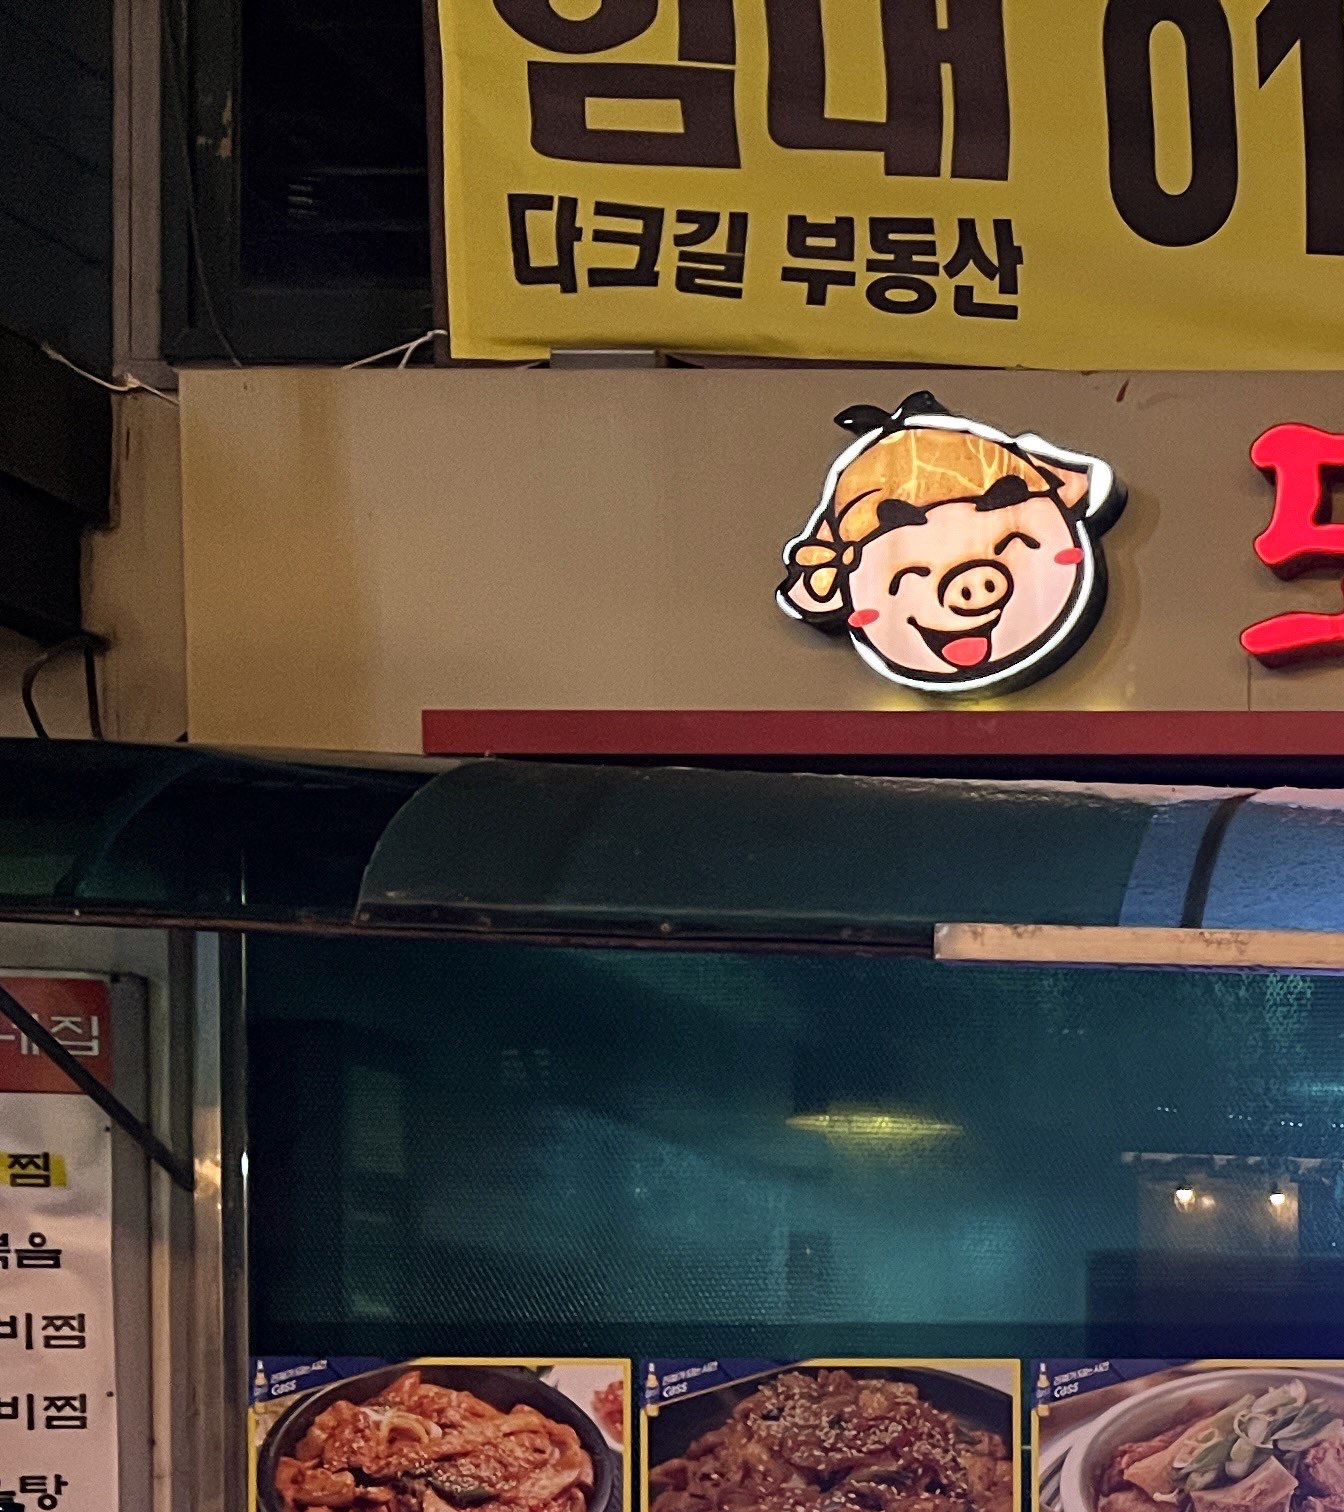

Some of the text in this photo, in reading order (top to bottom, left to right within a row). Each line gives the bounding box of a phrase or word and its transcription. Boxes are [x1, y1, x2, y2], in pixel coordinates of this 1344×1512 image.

[506, 193, 1023, 321] 다크길 부동산
[0, 1474, 69, 1511] 탕
